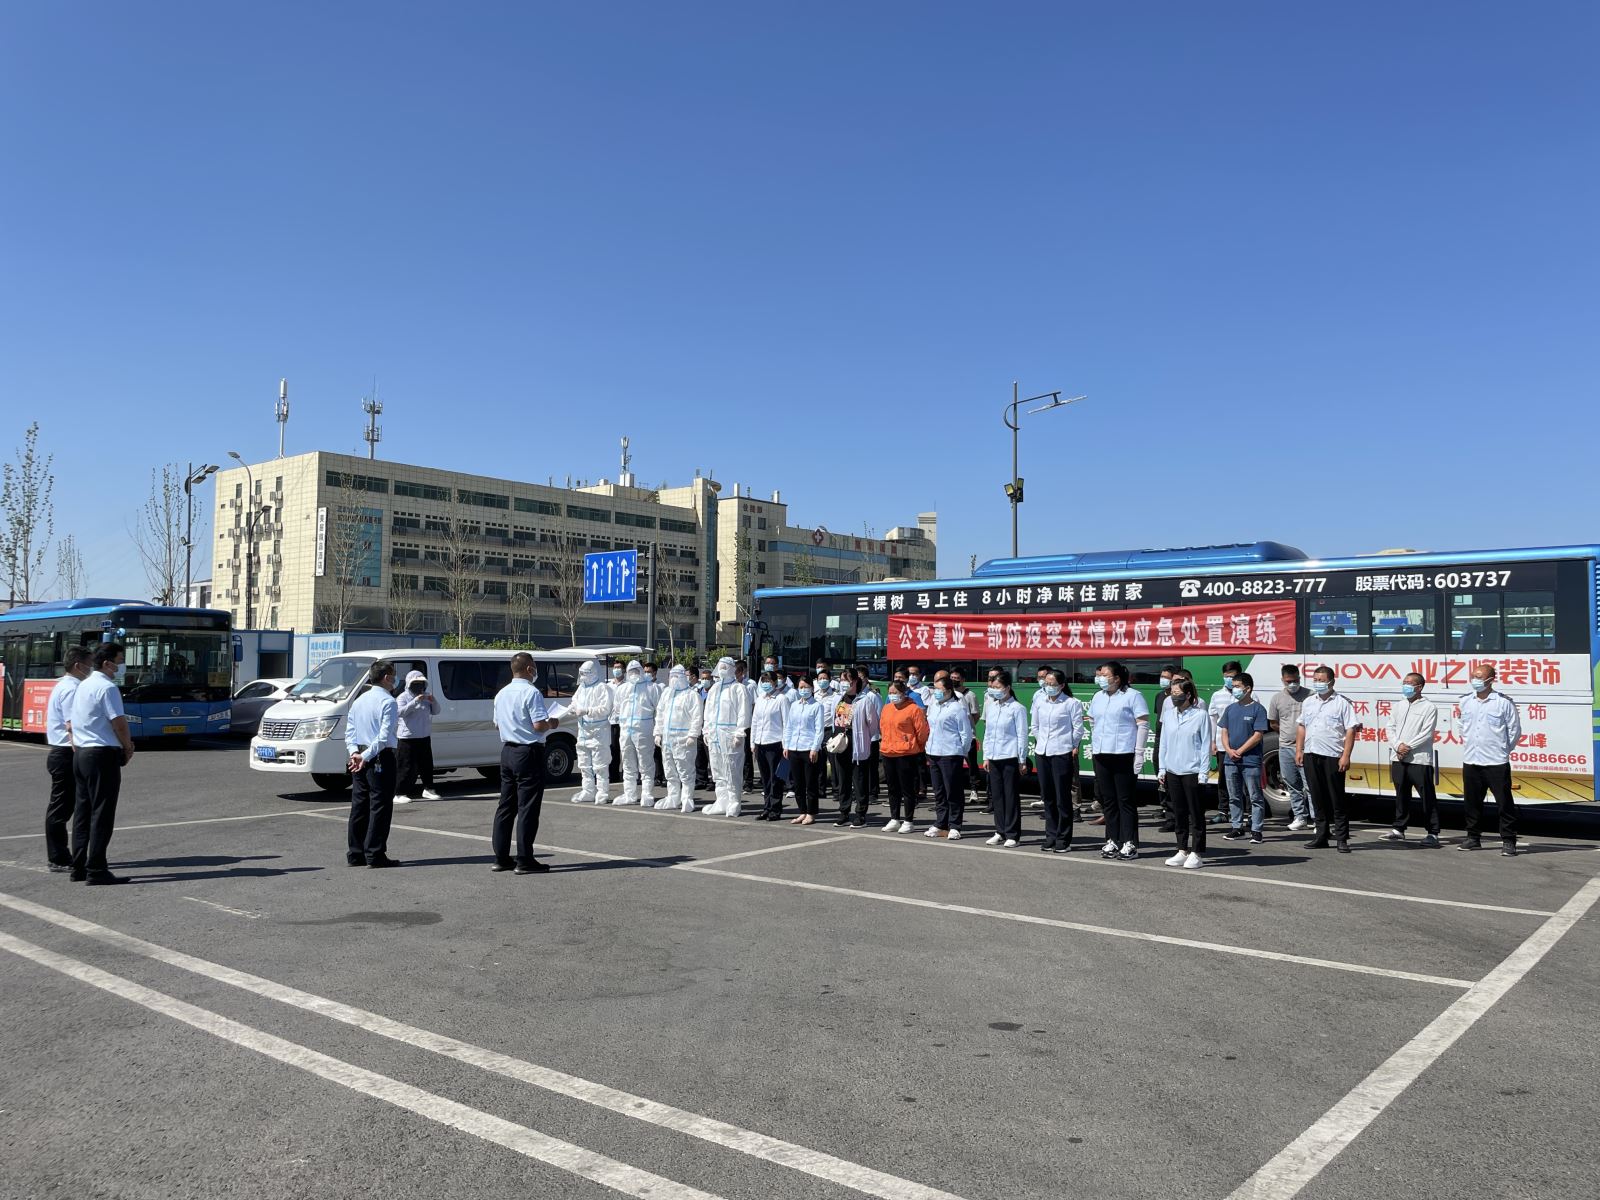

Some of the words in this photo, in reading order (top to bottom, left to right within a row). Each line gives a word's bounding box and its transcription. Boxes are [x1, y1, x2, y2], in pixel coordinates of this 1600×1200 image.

[1203, 578, 1327, 596] 400-8823-777
[1355, 571, 1511, 592] 股票代码:603737
[856, 594, 905, 611] 三棵树
[916, 591, 968, 608] 马上住
[982, 583, 1143, 605] 8小时净味住新家
[898, 613, 1277, 650] 公交事业一部防疫突发情况应急处置演练
[1280, 663, 1401, 680] ENOVA
